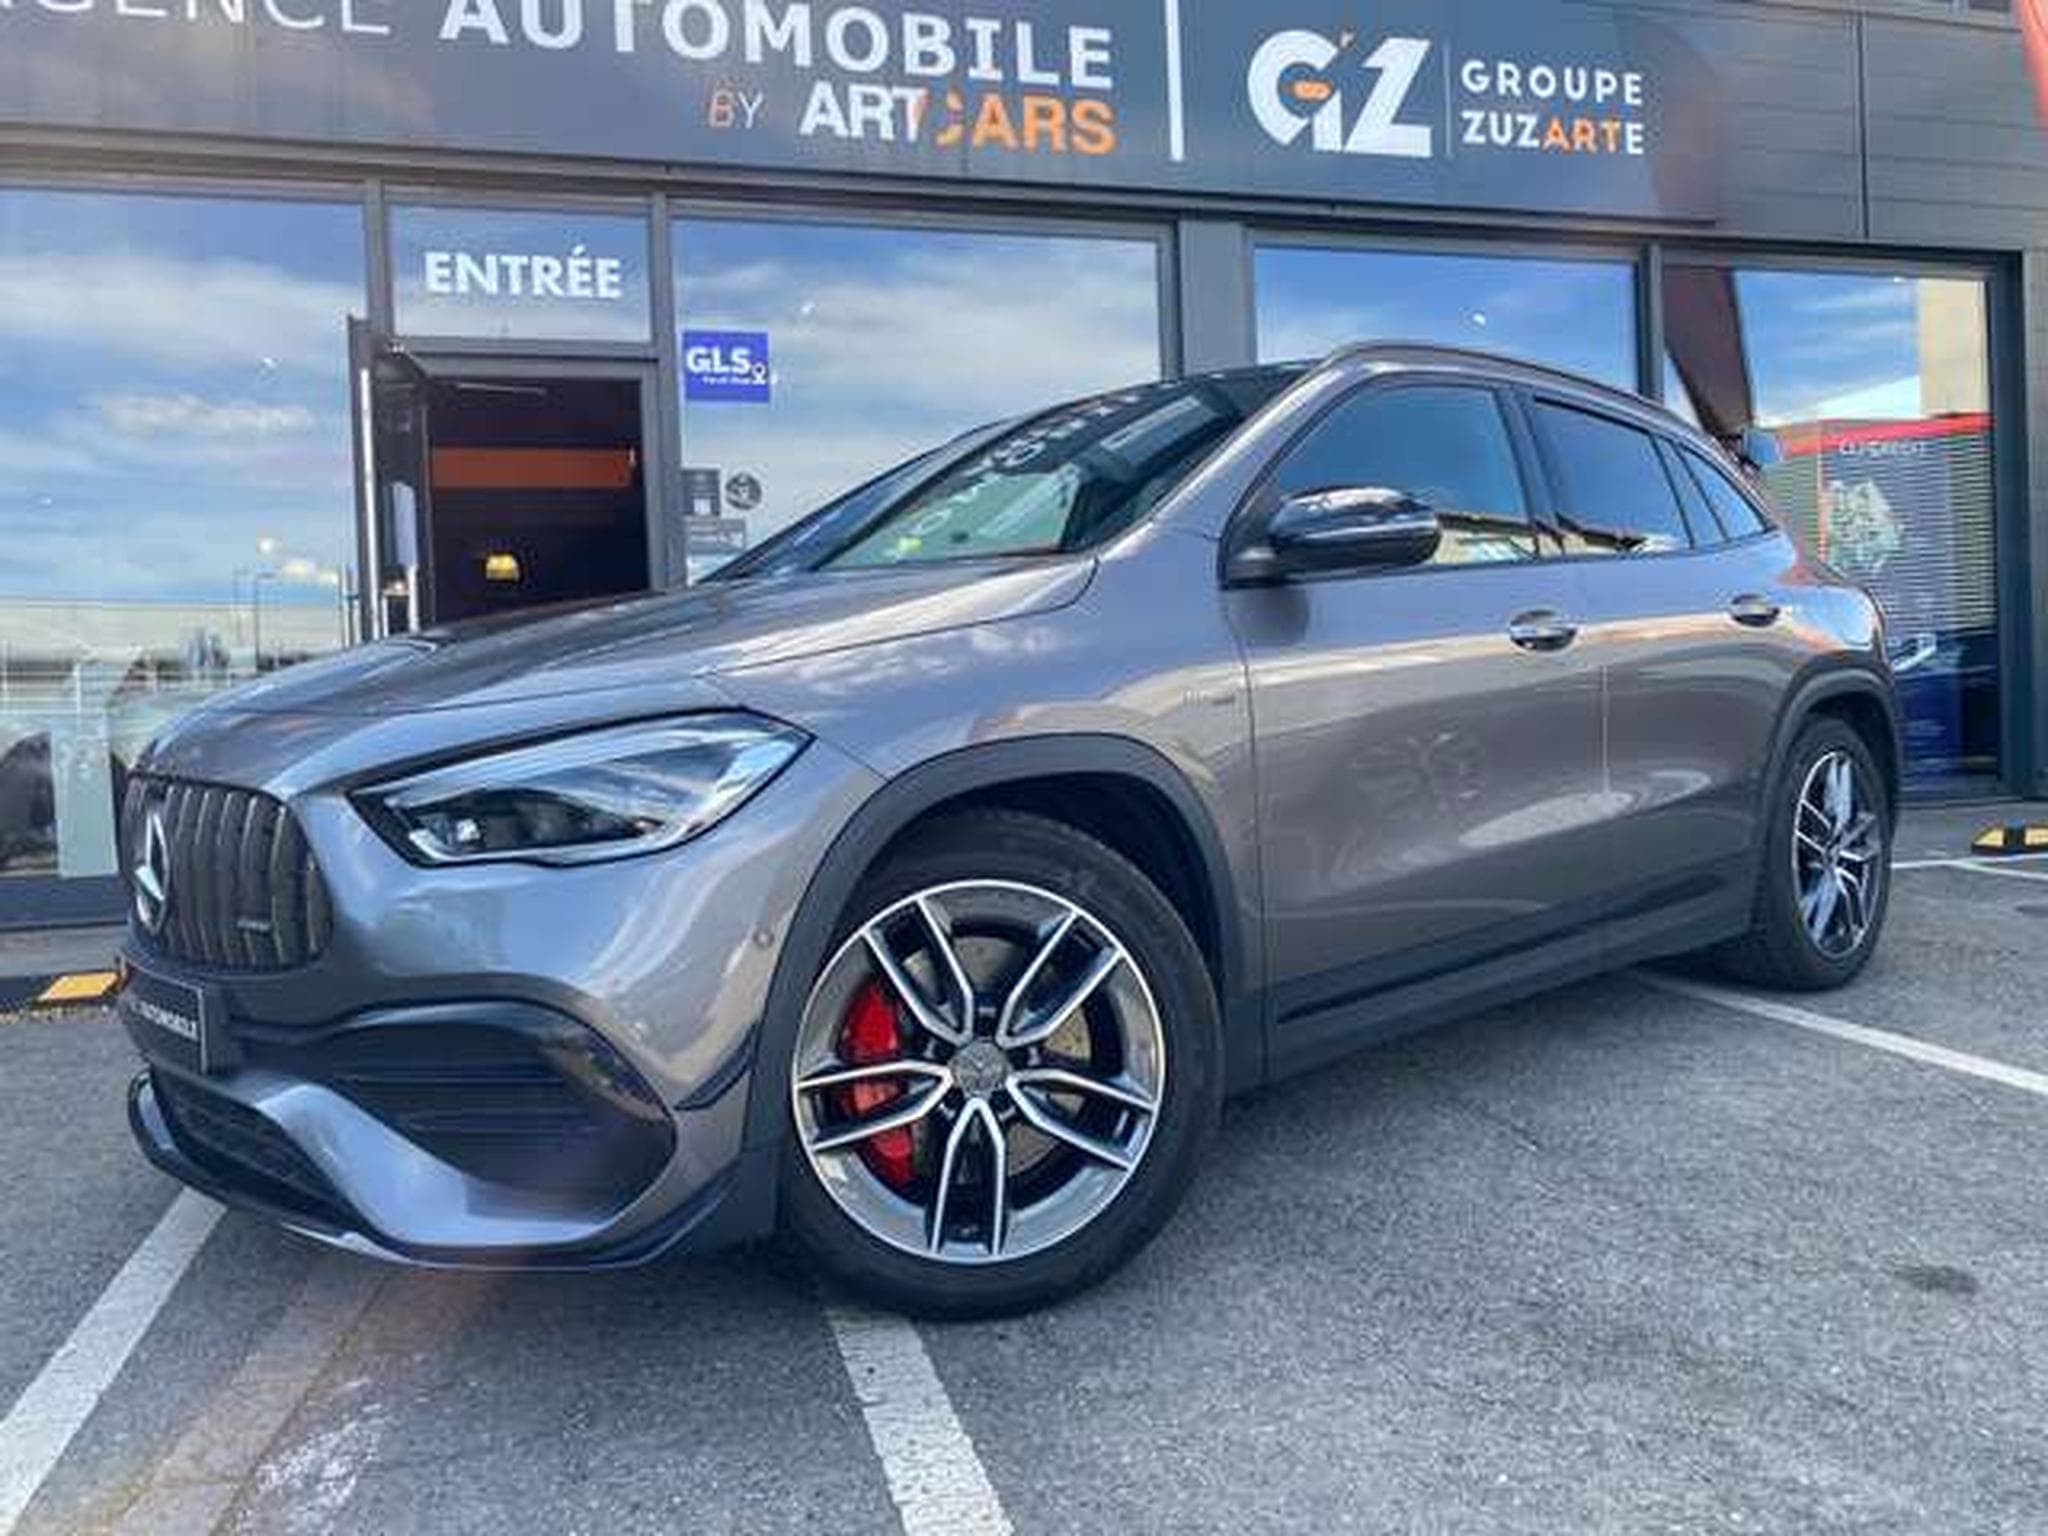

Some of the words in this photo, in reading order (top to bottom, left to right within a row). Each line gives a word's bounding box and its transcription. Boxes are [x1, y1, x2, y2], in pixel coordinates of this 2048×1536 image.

[439, 0, 1113, 87] AUTOMOBILE
[1461, 60, 1643, 105] GROUPE
[710, 88, 764, 129] BY
[1461, 110, 1644, 155] ZUZARTE
[425, 244, 622, 298] ENTRÉE
[687, 346, 751, 375] GLS
